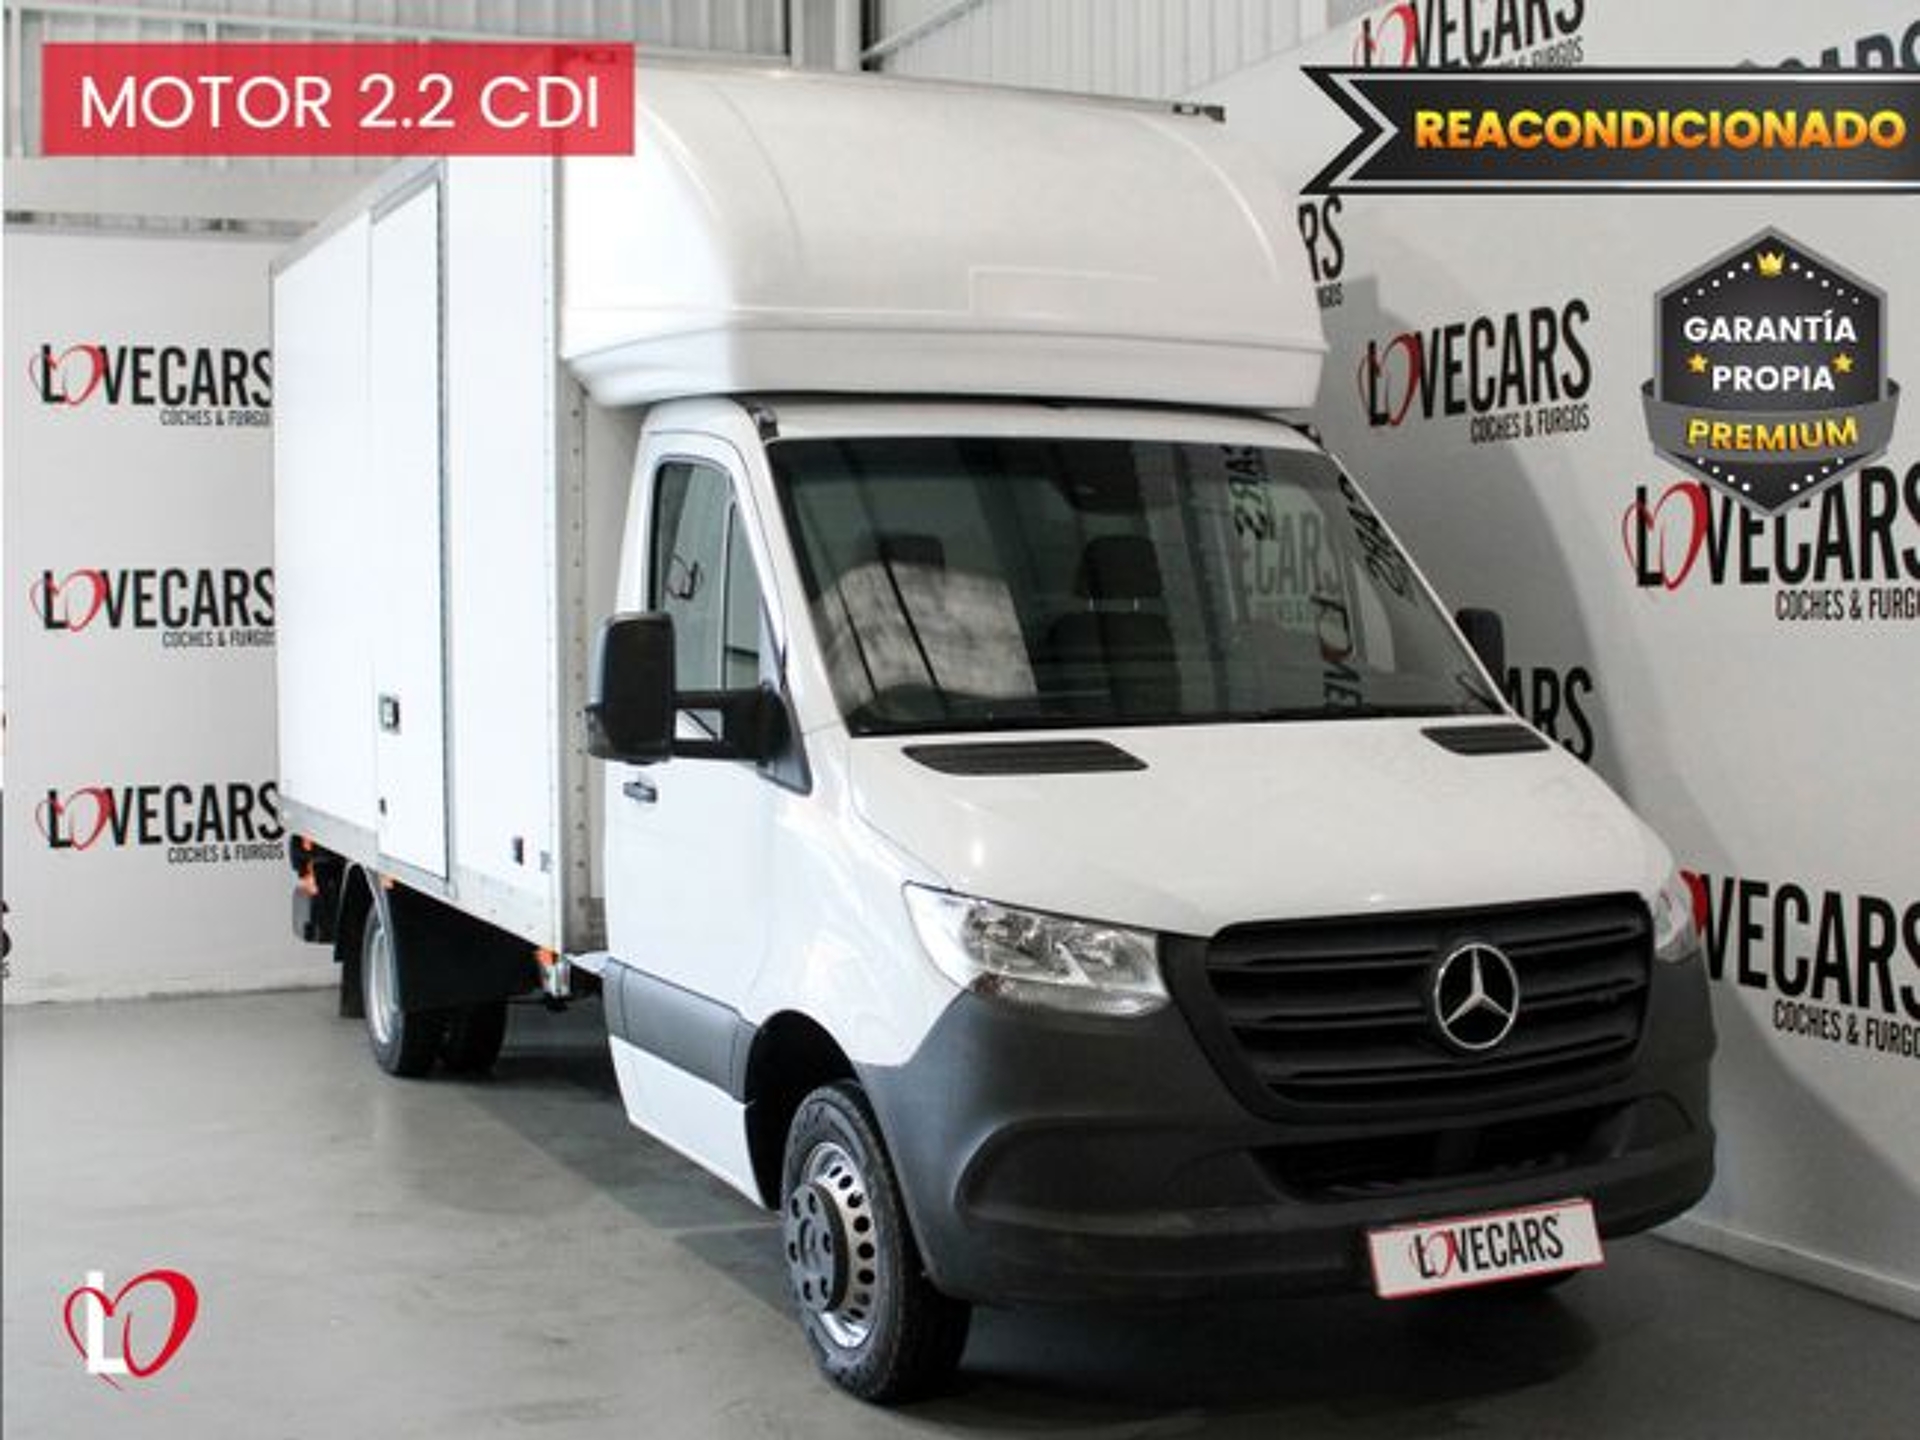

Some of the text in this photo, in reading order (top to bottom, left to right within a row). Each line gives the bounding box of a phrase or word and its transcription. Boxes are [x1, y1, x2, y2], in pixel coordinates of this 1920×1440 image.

[29, 344, 272, 407] LOVECARS
[1358, 299, 1592, 427] LOVECARS
[1471, 403, 1590, 444] COCHES & FURGOS
[29, 568, 275, 632] LOVECARS
[1775, 590, 1844, 621] COCHES
[1849, 587, 1861, 620] &
[35, 781, 285, 851] LOVECARS
[168, 846, 219, 863] COCHES
[1774, 998, 1841, 1042] COCHES
[1847, 1012, 1859, 1045] &
[1408, 1215, 1564, 1279] LOVECARS
